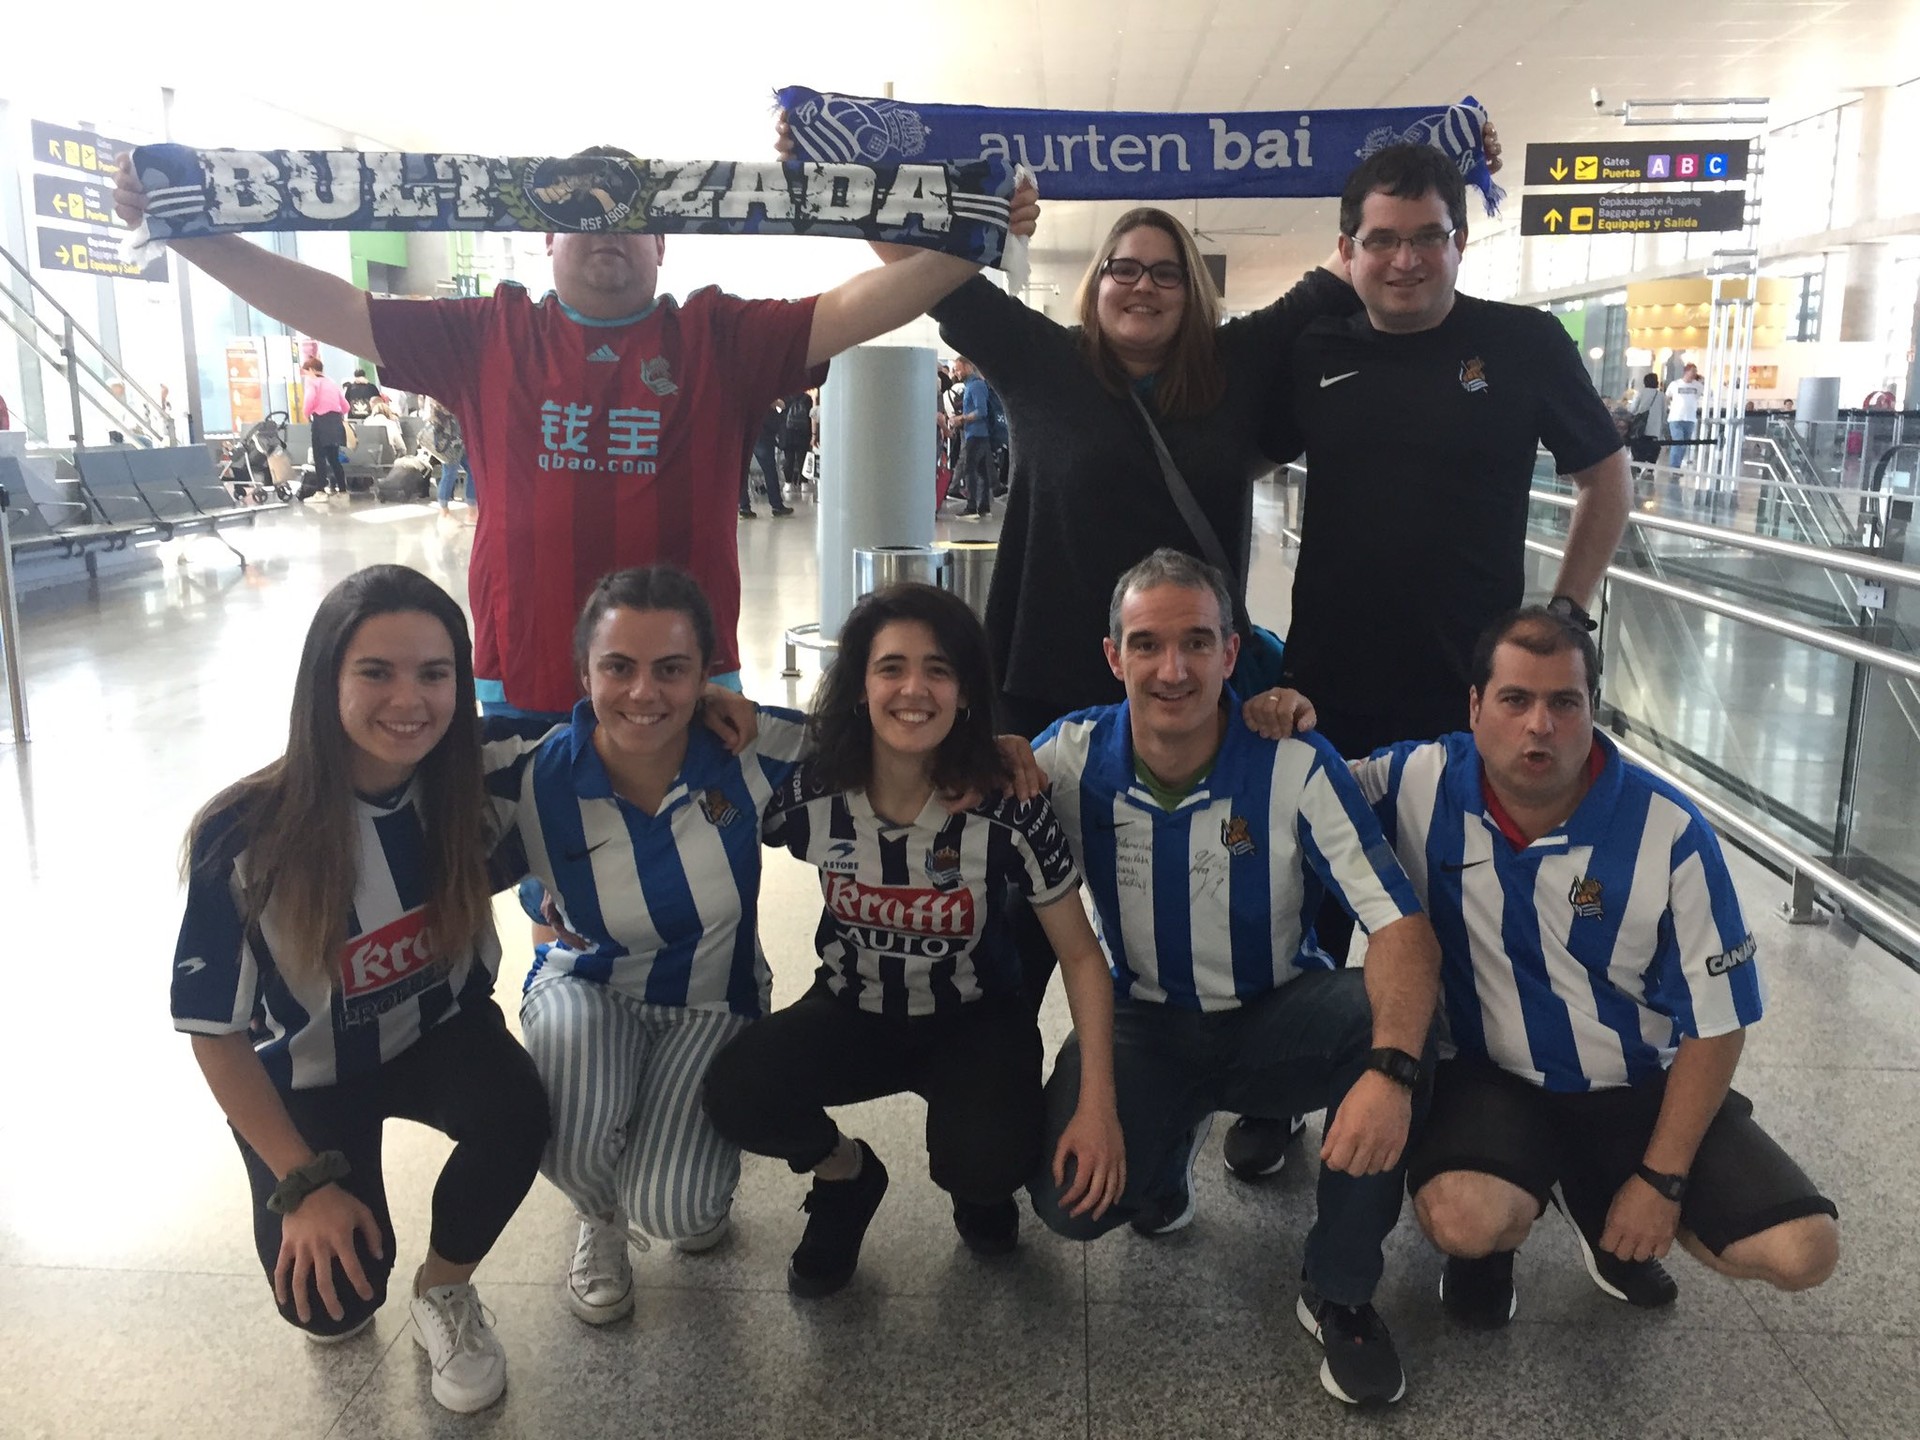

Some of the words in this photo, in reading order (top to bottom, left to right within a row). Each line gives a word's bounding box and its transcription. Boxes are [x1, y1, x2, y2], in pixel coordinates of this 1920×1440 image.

[979, 124, 1191, 173] aurten
[1209, 115, 1313, 171] bai
[1602, 157, 1630, 166] Gates
[1651, 158, 1665, 175] A
[1681, 157, 1694, 174] B
[1709, 157, 1722, 174] C
[1602, 168, 1641, 179] Puertas
[650, 159, 955, 233] ZADA
[580, 217, 602, 231] RSF
[605, 202, 630, 225] 1909
[1598, 207, 1637, 218] Baggage
[1640, 207, 1655, 216] and
[1658, 207, 1674, 216] exit
[1598, 218, 1651, 231] Equipajes
[1653, 220, 1661, 231] y
[1664, 218, 1698, 228] Salida
[541, 400, 661, 457] 钱宝
[538, 452, 656, 475] qbao.com
[822, 861, 859, 870] ASTORE
[829, 875, 968, 933] Krafft
[846, 927, 950, 957] AUTO
